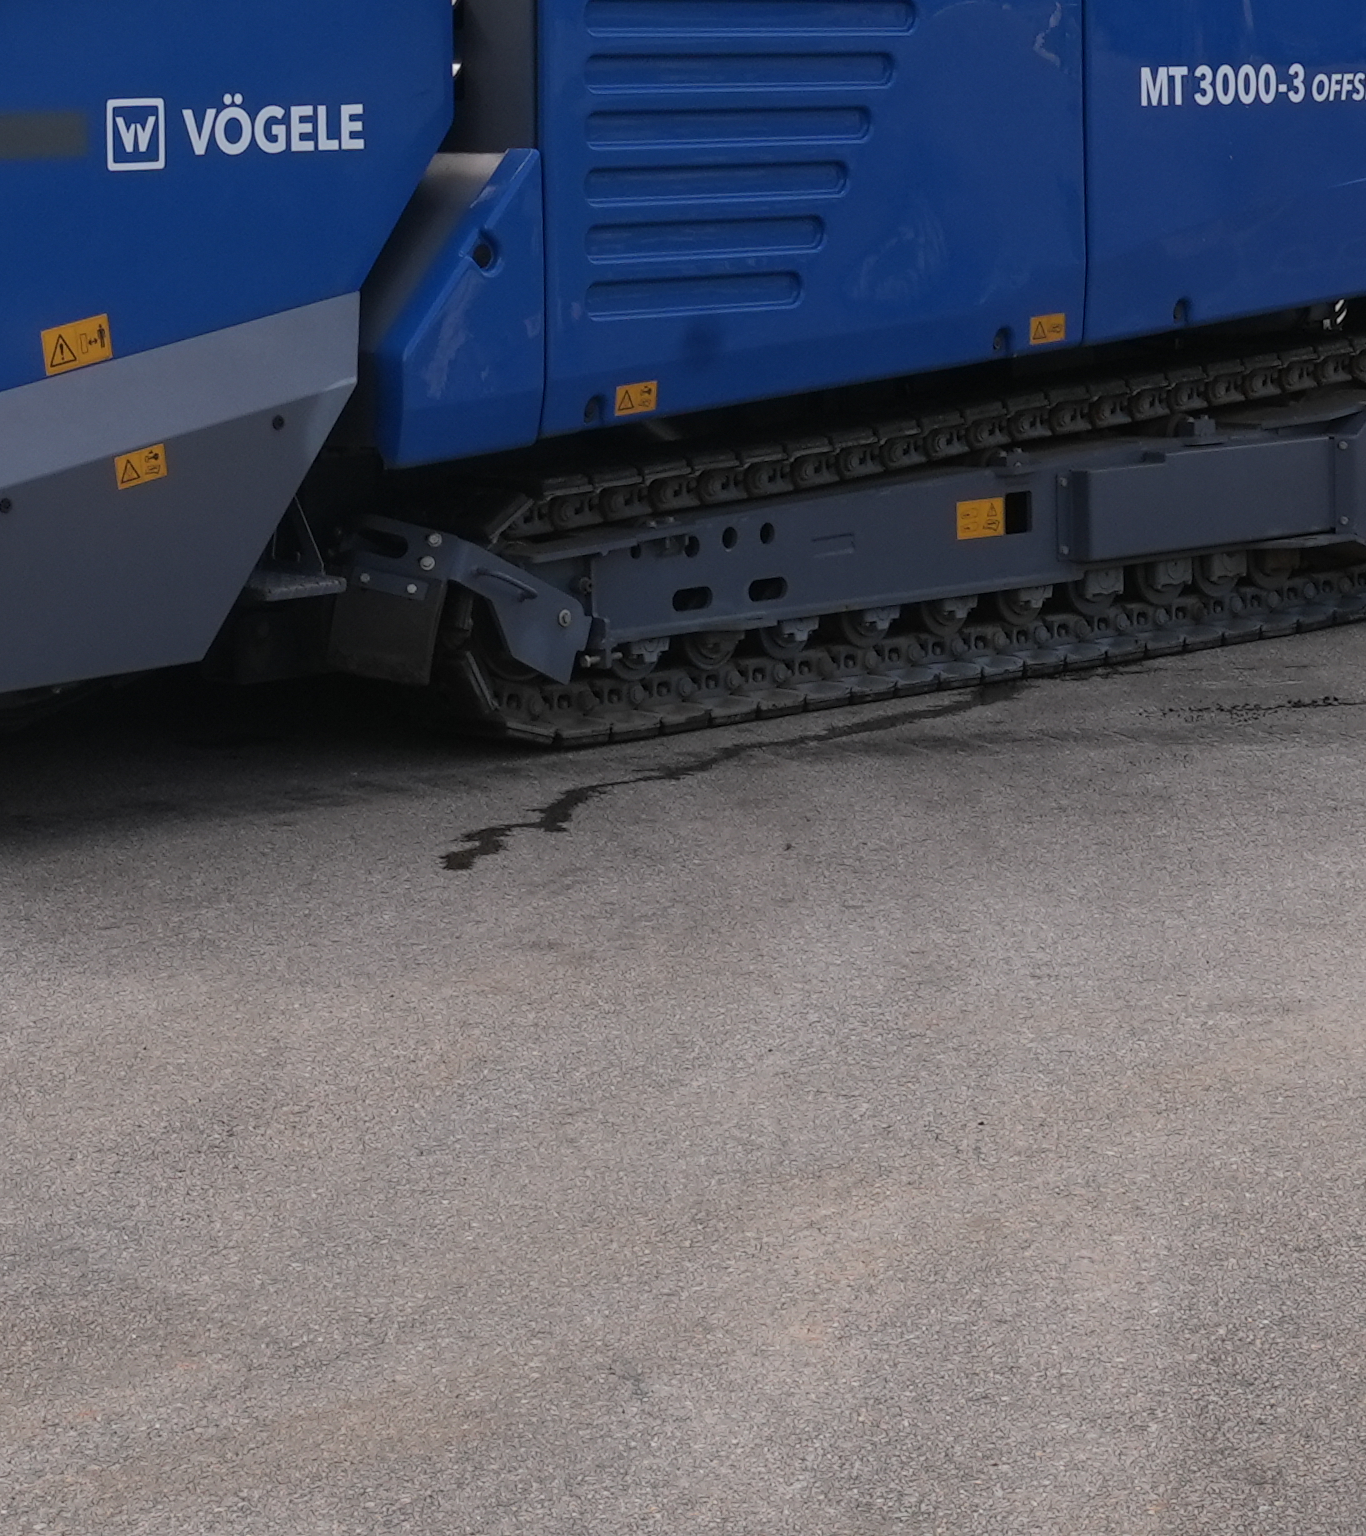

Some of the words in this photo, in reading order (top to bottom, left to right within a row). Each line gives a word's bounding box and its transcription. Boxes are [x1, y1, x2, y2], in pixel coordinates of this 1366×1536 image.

[1140, 66, 1188, 106] MT
[1193, 62, 1306, 106] 3000-3
[182, 93, 365, 156] VÖGELE
